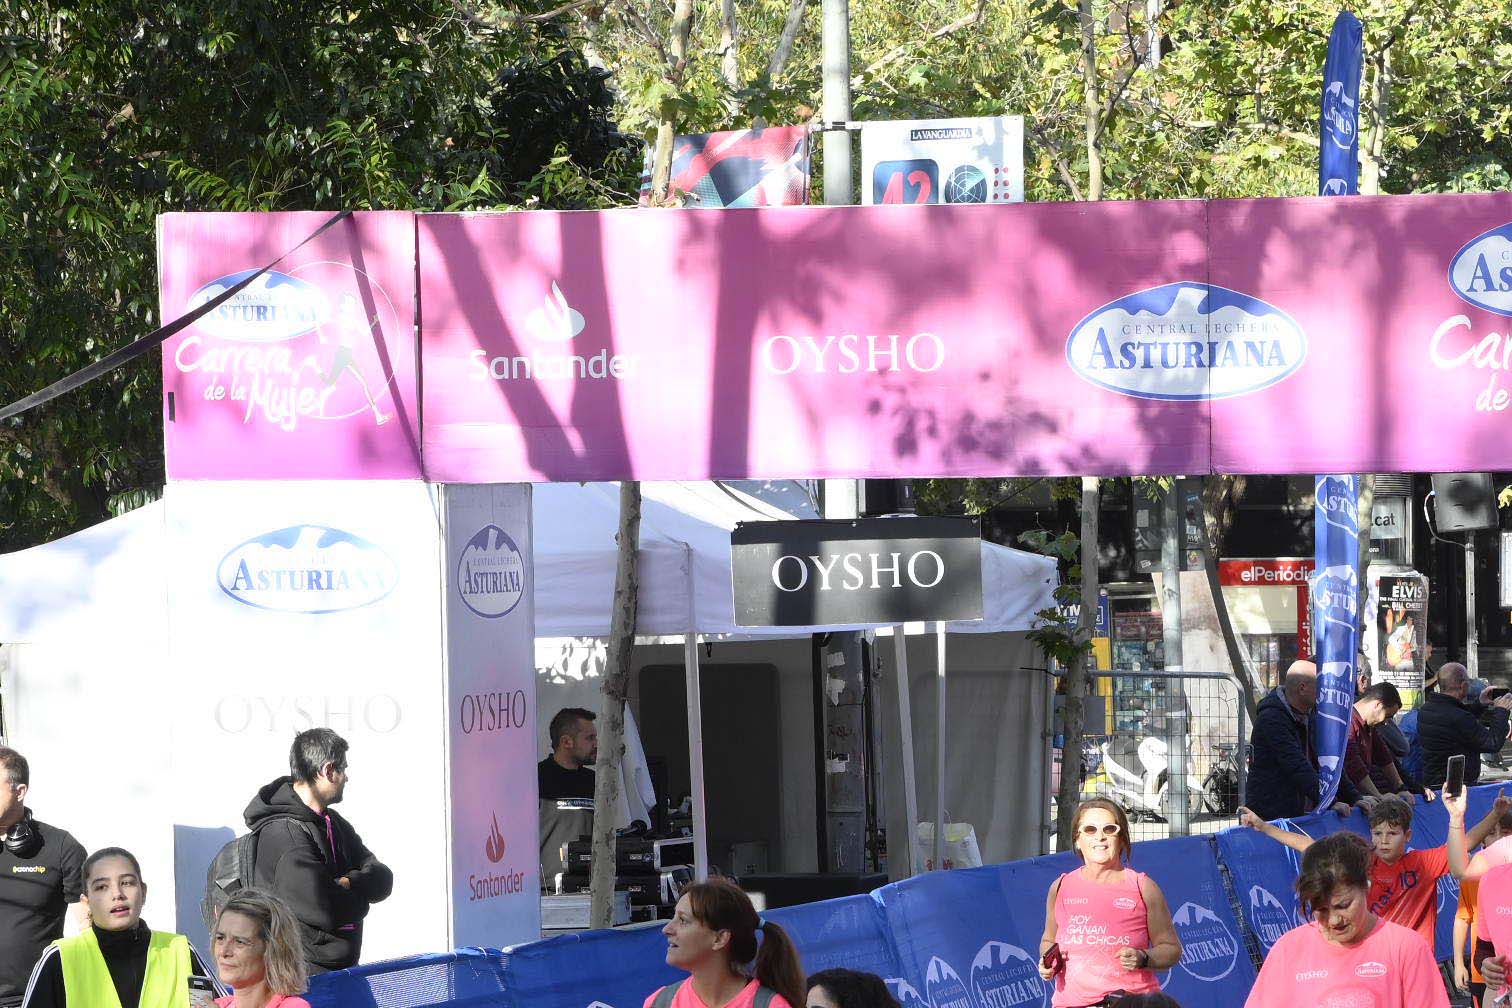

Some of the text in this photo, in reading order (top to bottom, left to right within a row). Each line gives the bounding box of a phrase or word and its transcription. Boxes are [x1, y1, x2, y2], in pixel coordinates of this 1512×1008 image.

[1122, 322, 1280, 336] CENTRAL LECHERA
[175, 336, 294, 373] Carrera
[468, 349, 639, 381] Santander
[762, 332, 945, 375] OYSHO
[1087, 327, 1287, 370] ASTURIANA
[203, 371, 336, 432] de la Mujer
[1476, 374, 1508, 412] de
[231, 557, 386, 591] ASTURIANA
[463, 560, 520, 594] ASTURIANA
[772, 550, 945, 591] OYSHO
[1392, 585, 1422, 598] ELVIS
[214, 693, 402, 735] OYSHO
[461, 689, 526, 734] OYSHO
[469, 872, 524, 902] Santander
[1066, 925, 1108, 934] GANAN
[1070, 915, 1091, 924] HOY
[1064, 935, 1130, 945] LAS CHICAS
